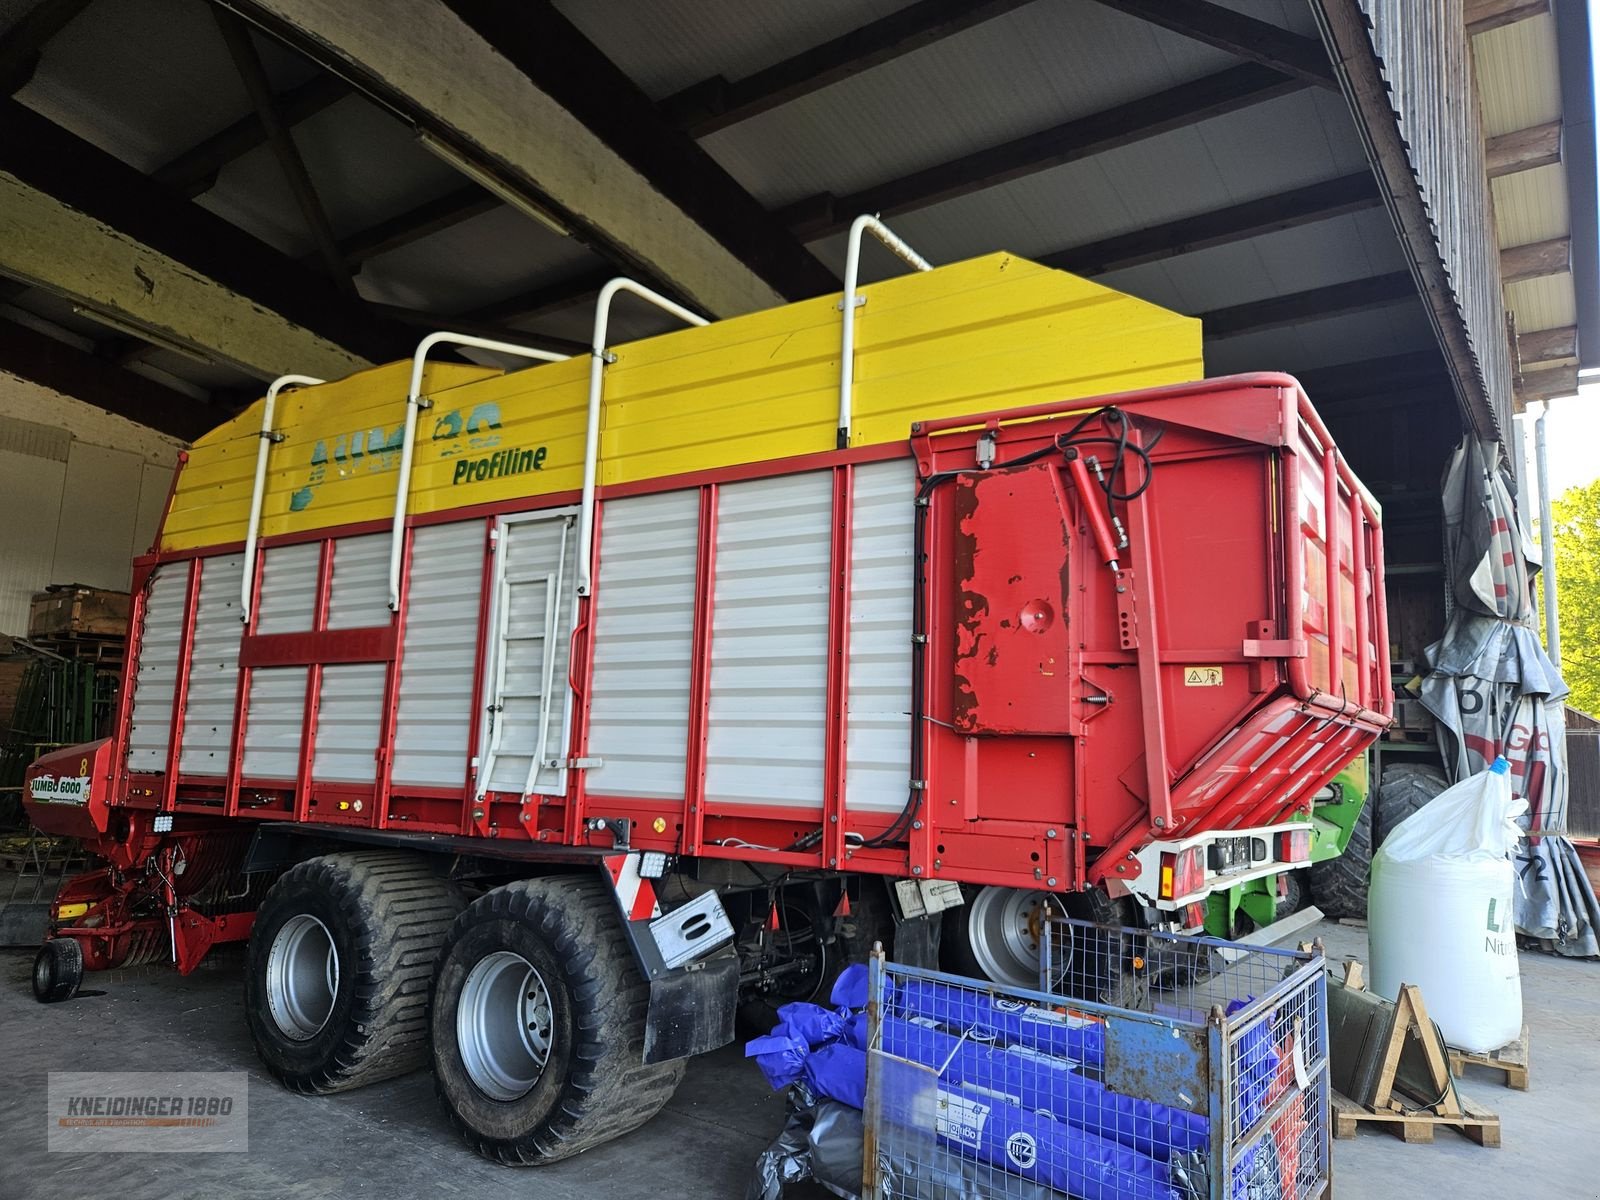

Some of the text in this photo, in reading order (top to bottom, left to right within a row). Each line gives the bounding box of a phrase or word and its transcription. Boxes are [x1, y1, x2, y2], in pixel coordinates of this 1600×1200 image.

[453, 446, 547, 485] Profiline
[80, 758, 88, 776] 8
[32, 780, 81, 794] JUMBO 6000
